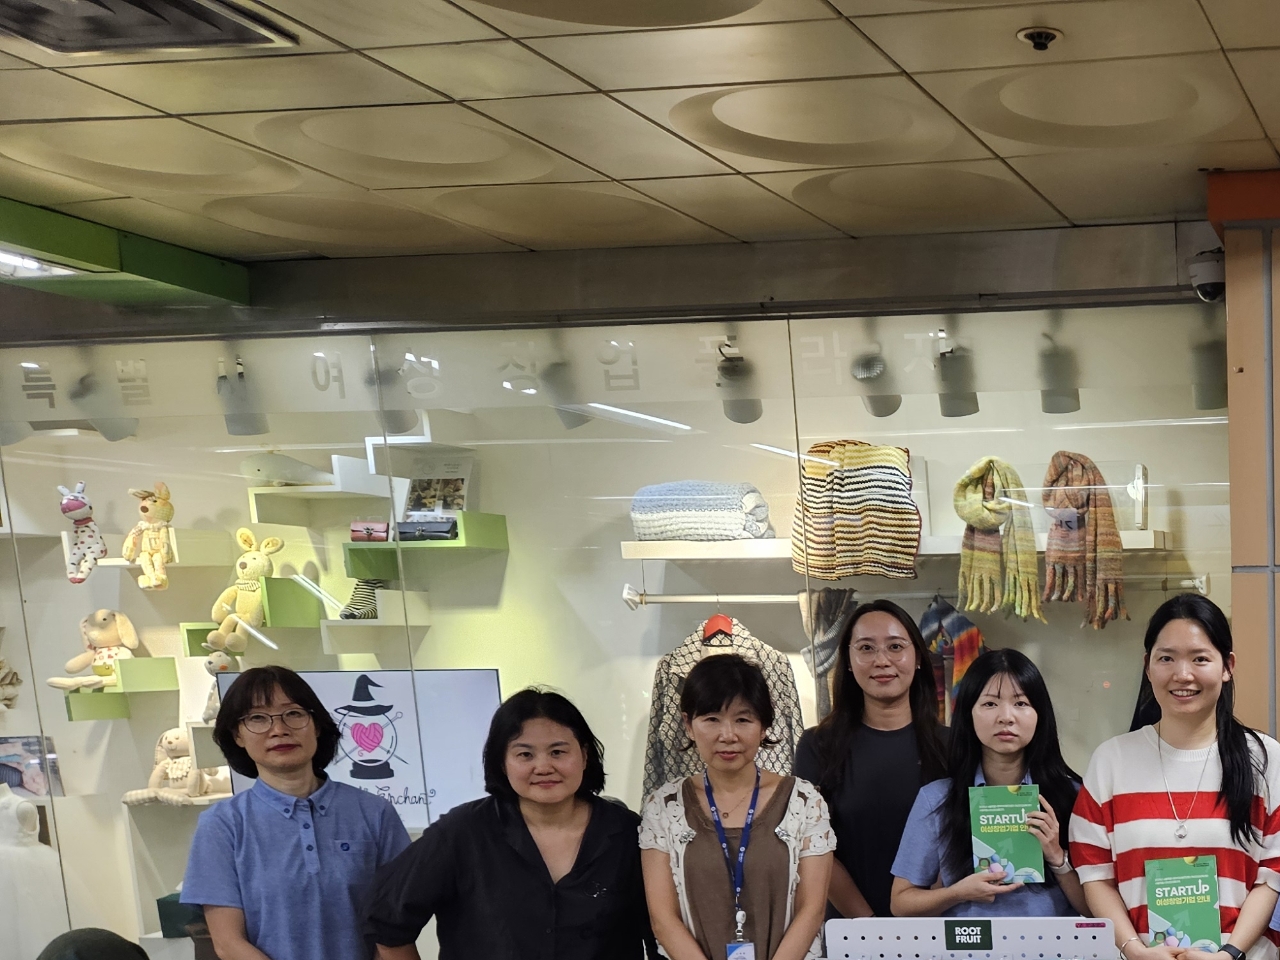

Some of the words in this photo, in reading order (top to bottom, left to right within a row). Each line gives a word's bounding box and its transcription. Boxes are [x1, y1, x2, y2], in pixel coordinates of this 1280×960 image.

[1155, 878, 1210, 898] STARTUP
[955, 926, 981, 935] ROOT
[955, 935, 981, 943] FRUIT
